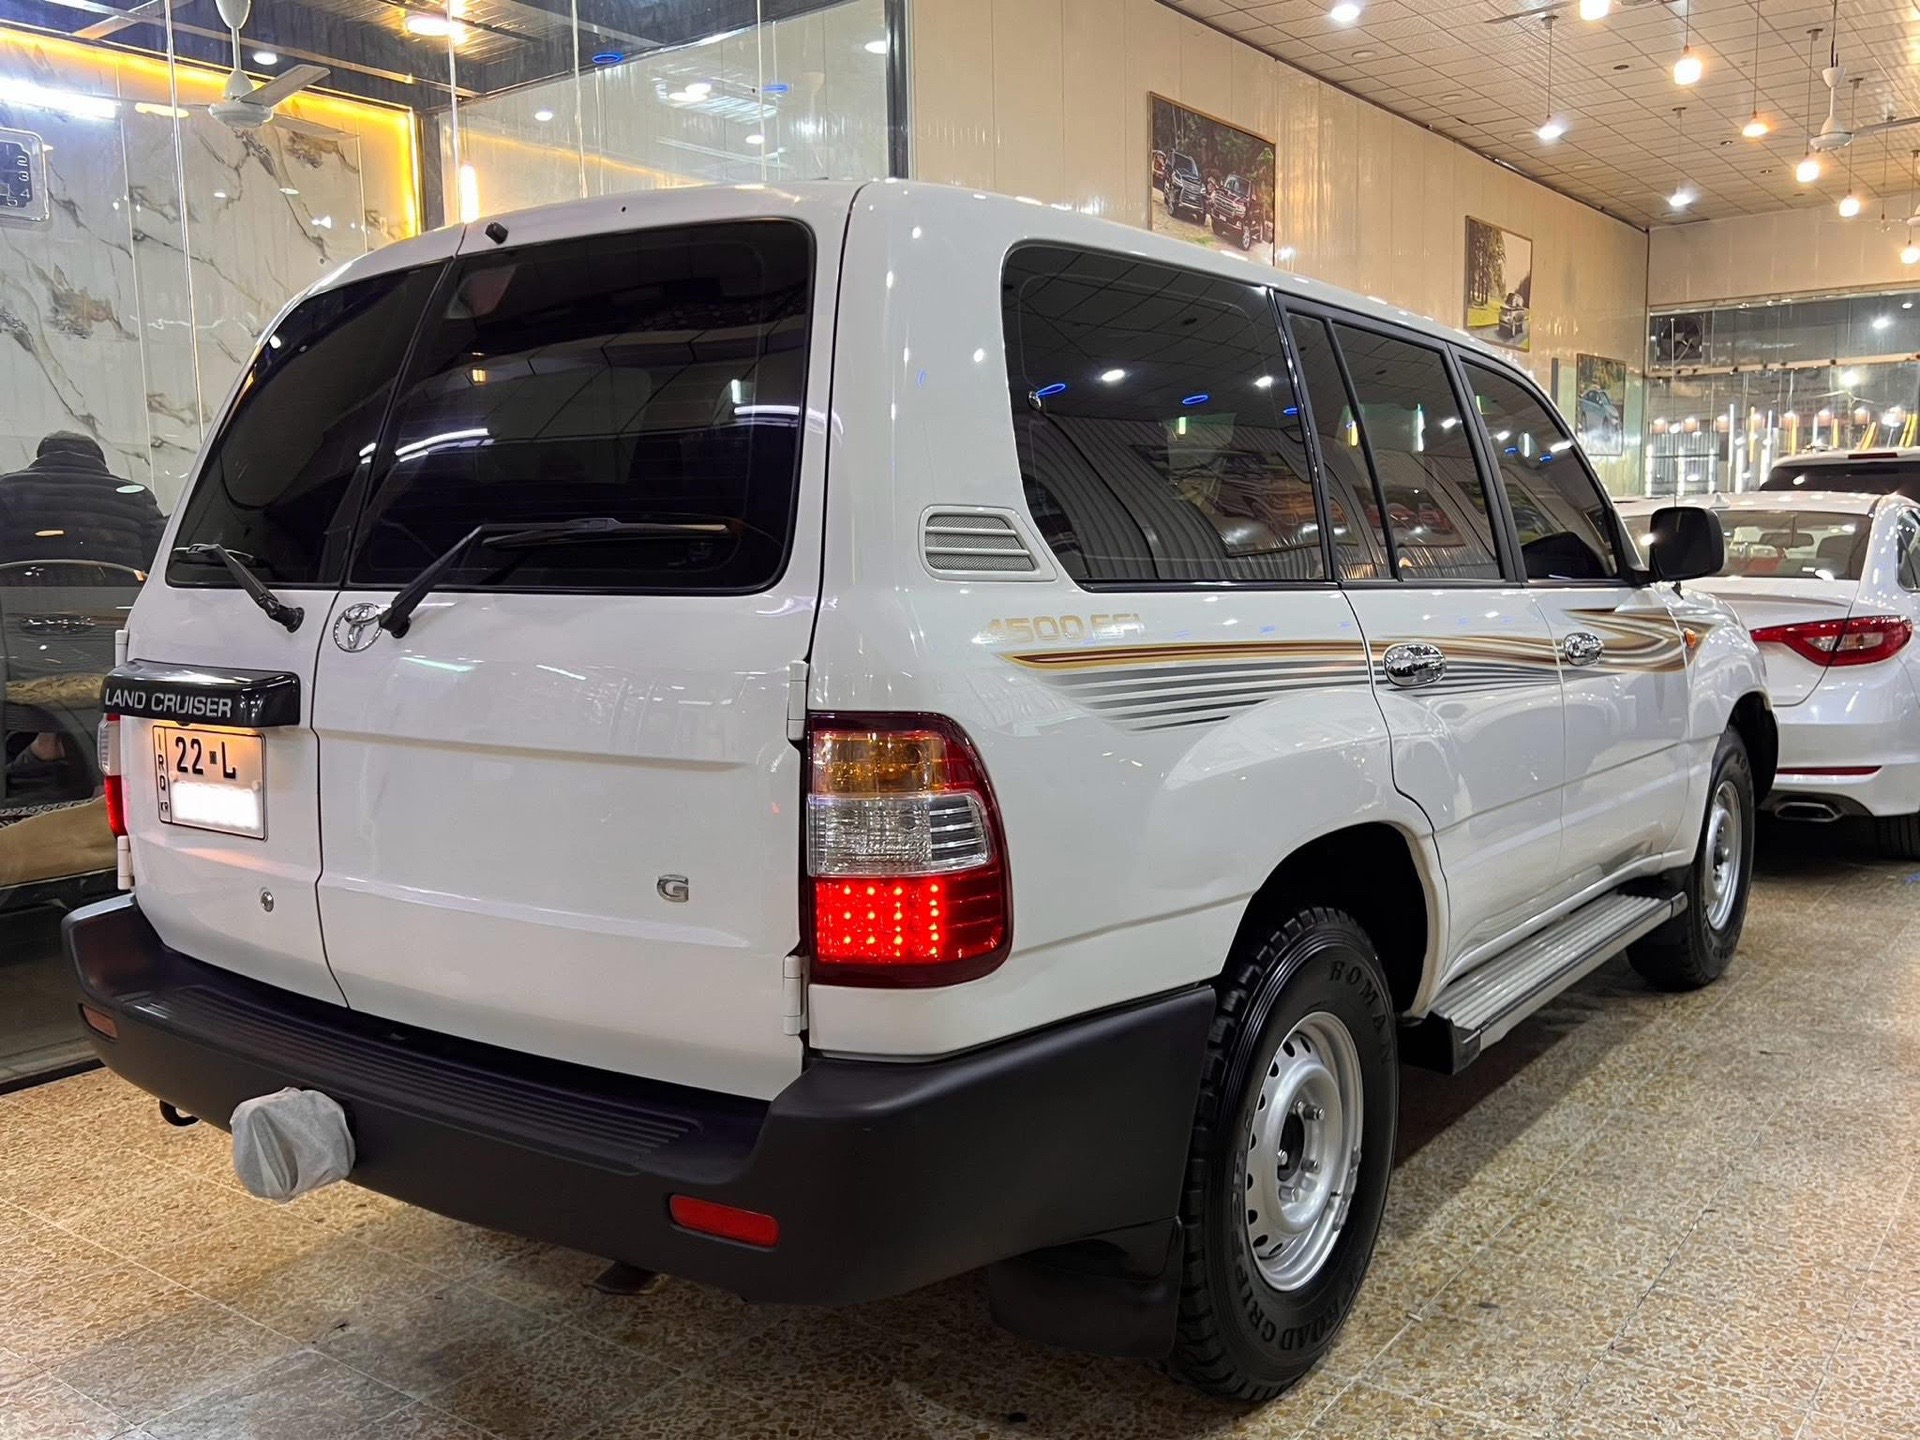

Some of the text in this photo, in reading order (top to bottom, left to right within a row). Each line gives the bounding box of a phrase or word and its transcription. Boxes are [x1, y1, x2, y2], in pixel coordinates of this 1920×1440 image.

[18, 170, 29, 182] 3
[20, 188, 30, 199] 4
[105, 688, 232, 718] LAND CRUISER
[656, 874, 689, 903] G
